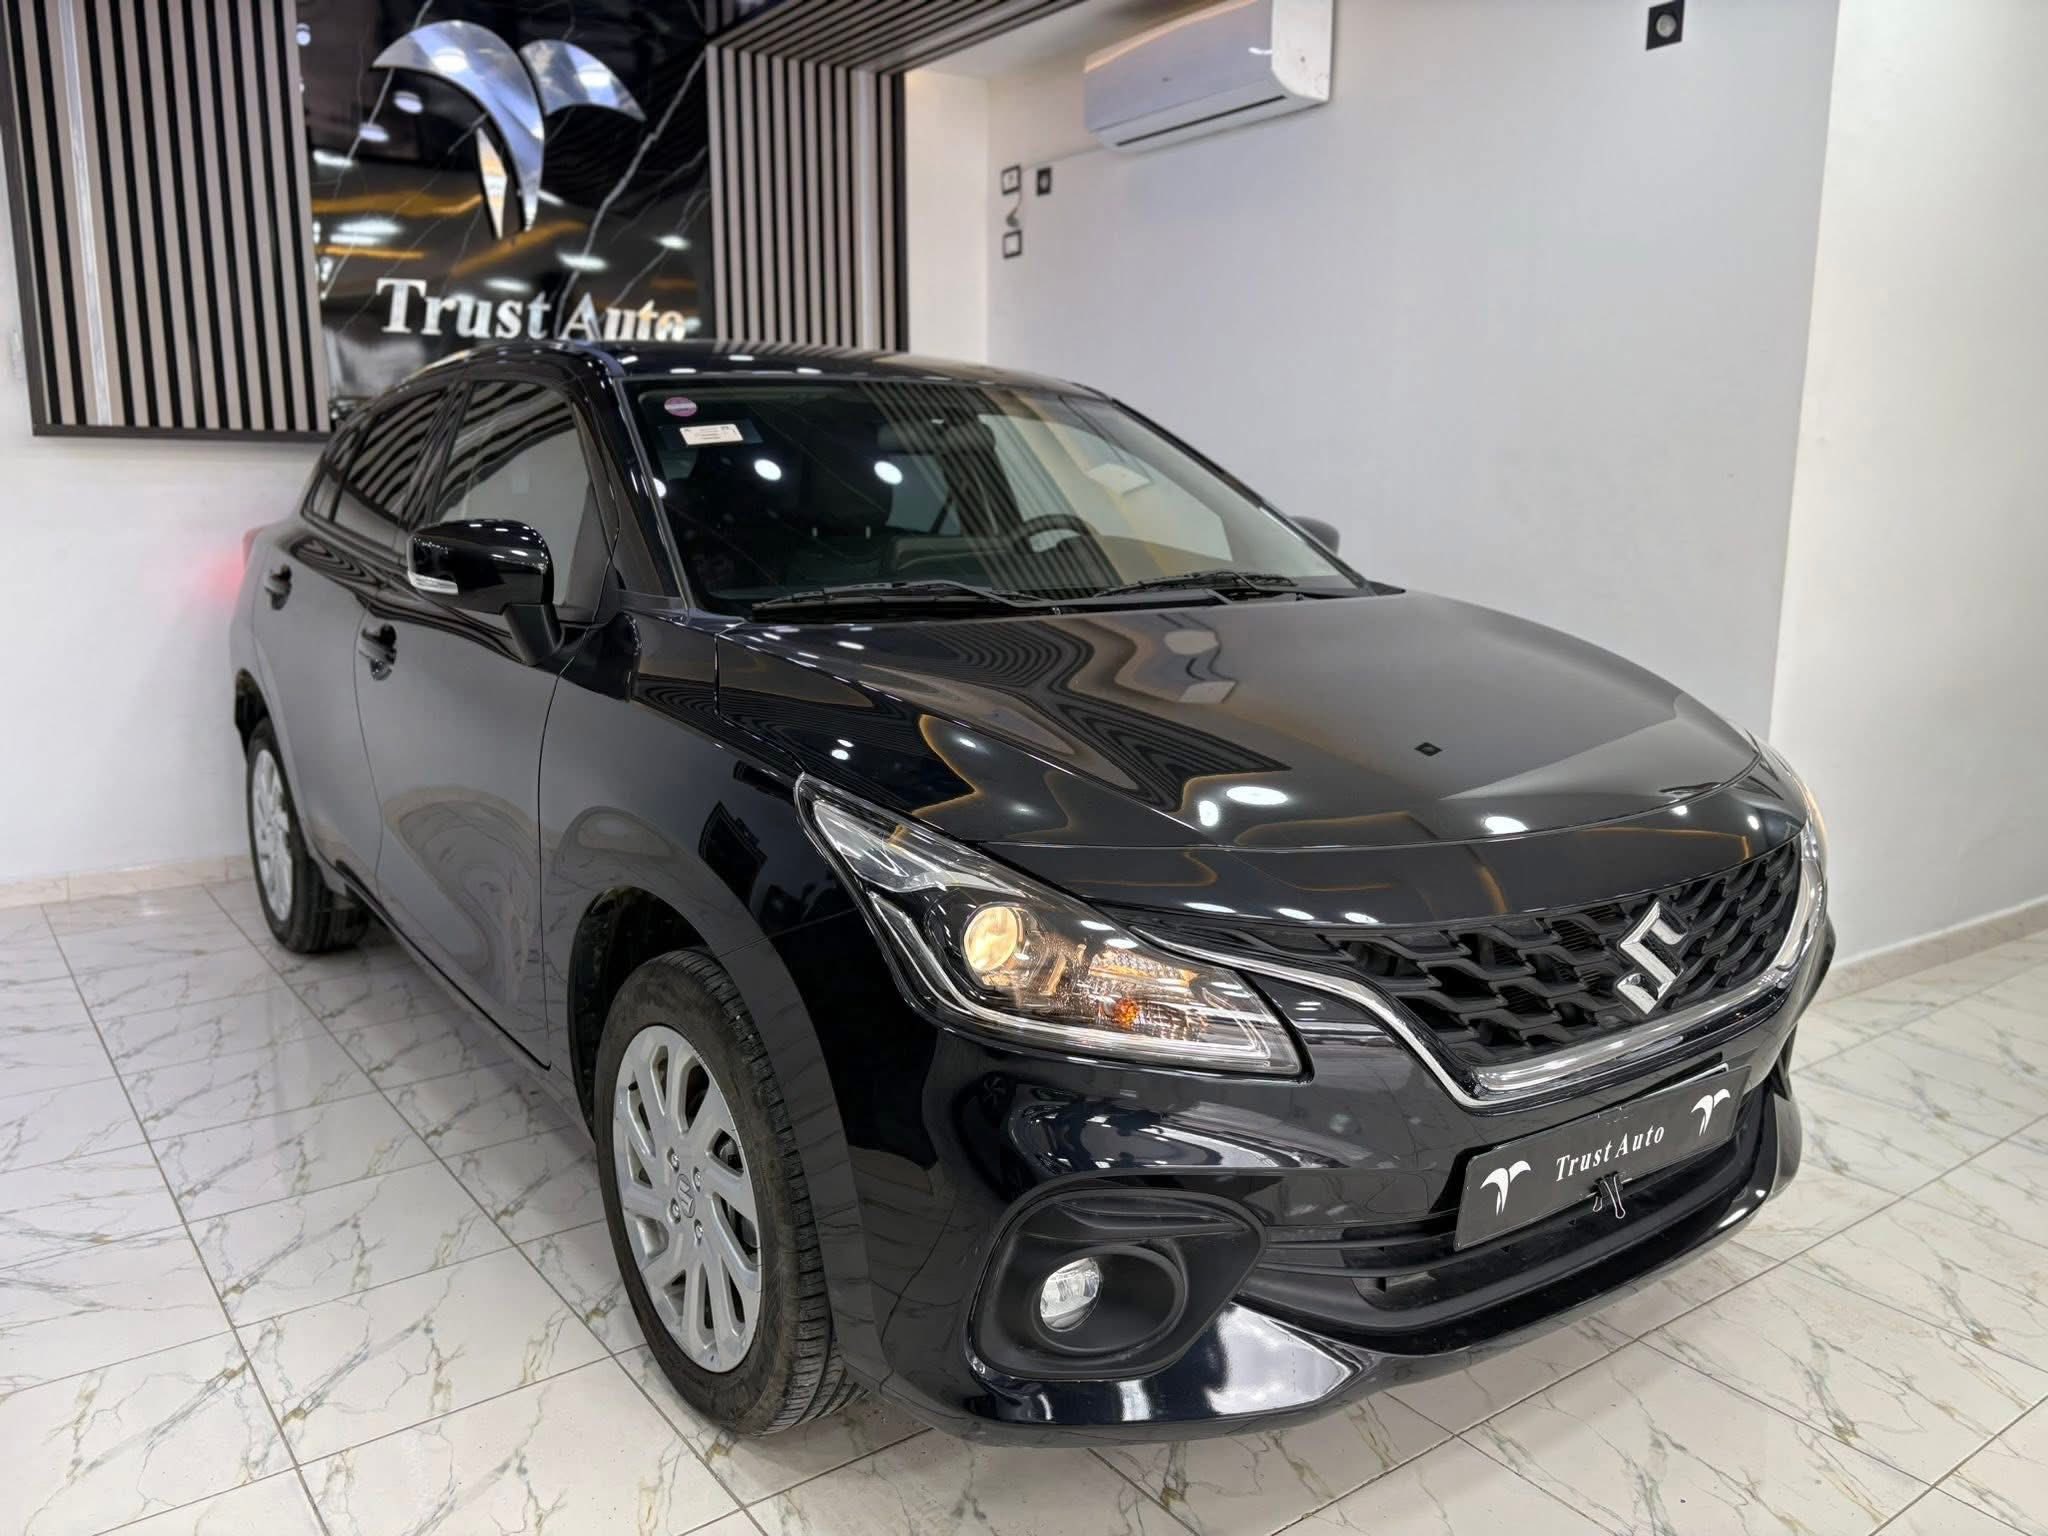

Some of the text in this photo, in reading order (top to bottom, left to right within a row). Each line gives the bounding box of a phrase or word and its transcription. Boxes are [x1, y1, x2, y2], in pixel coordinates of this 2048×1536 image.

[376, 277, 687, 342] Trust Auto
[1555, 1125, 1665, 1182] Trust Auto
